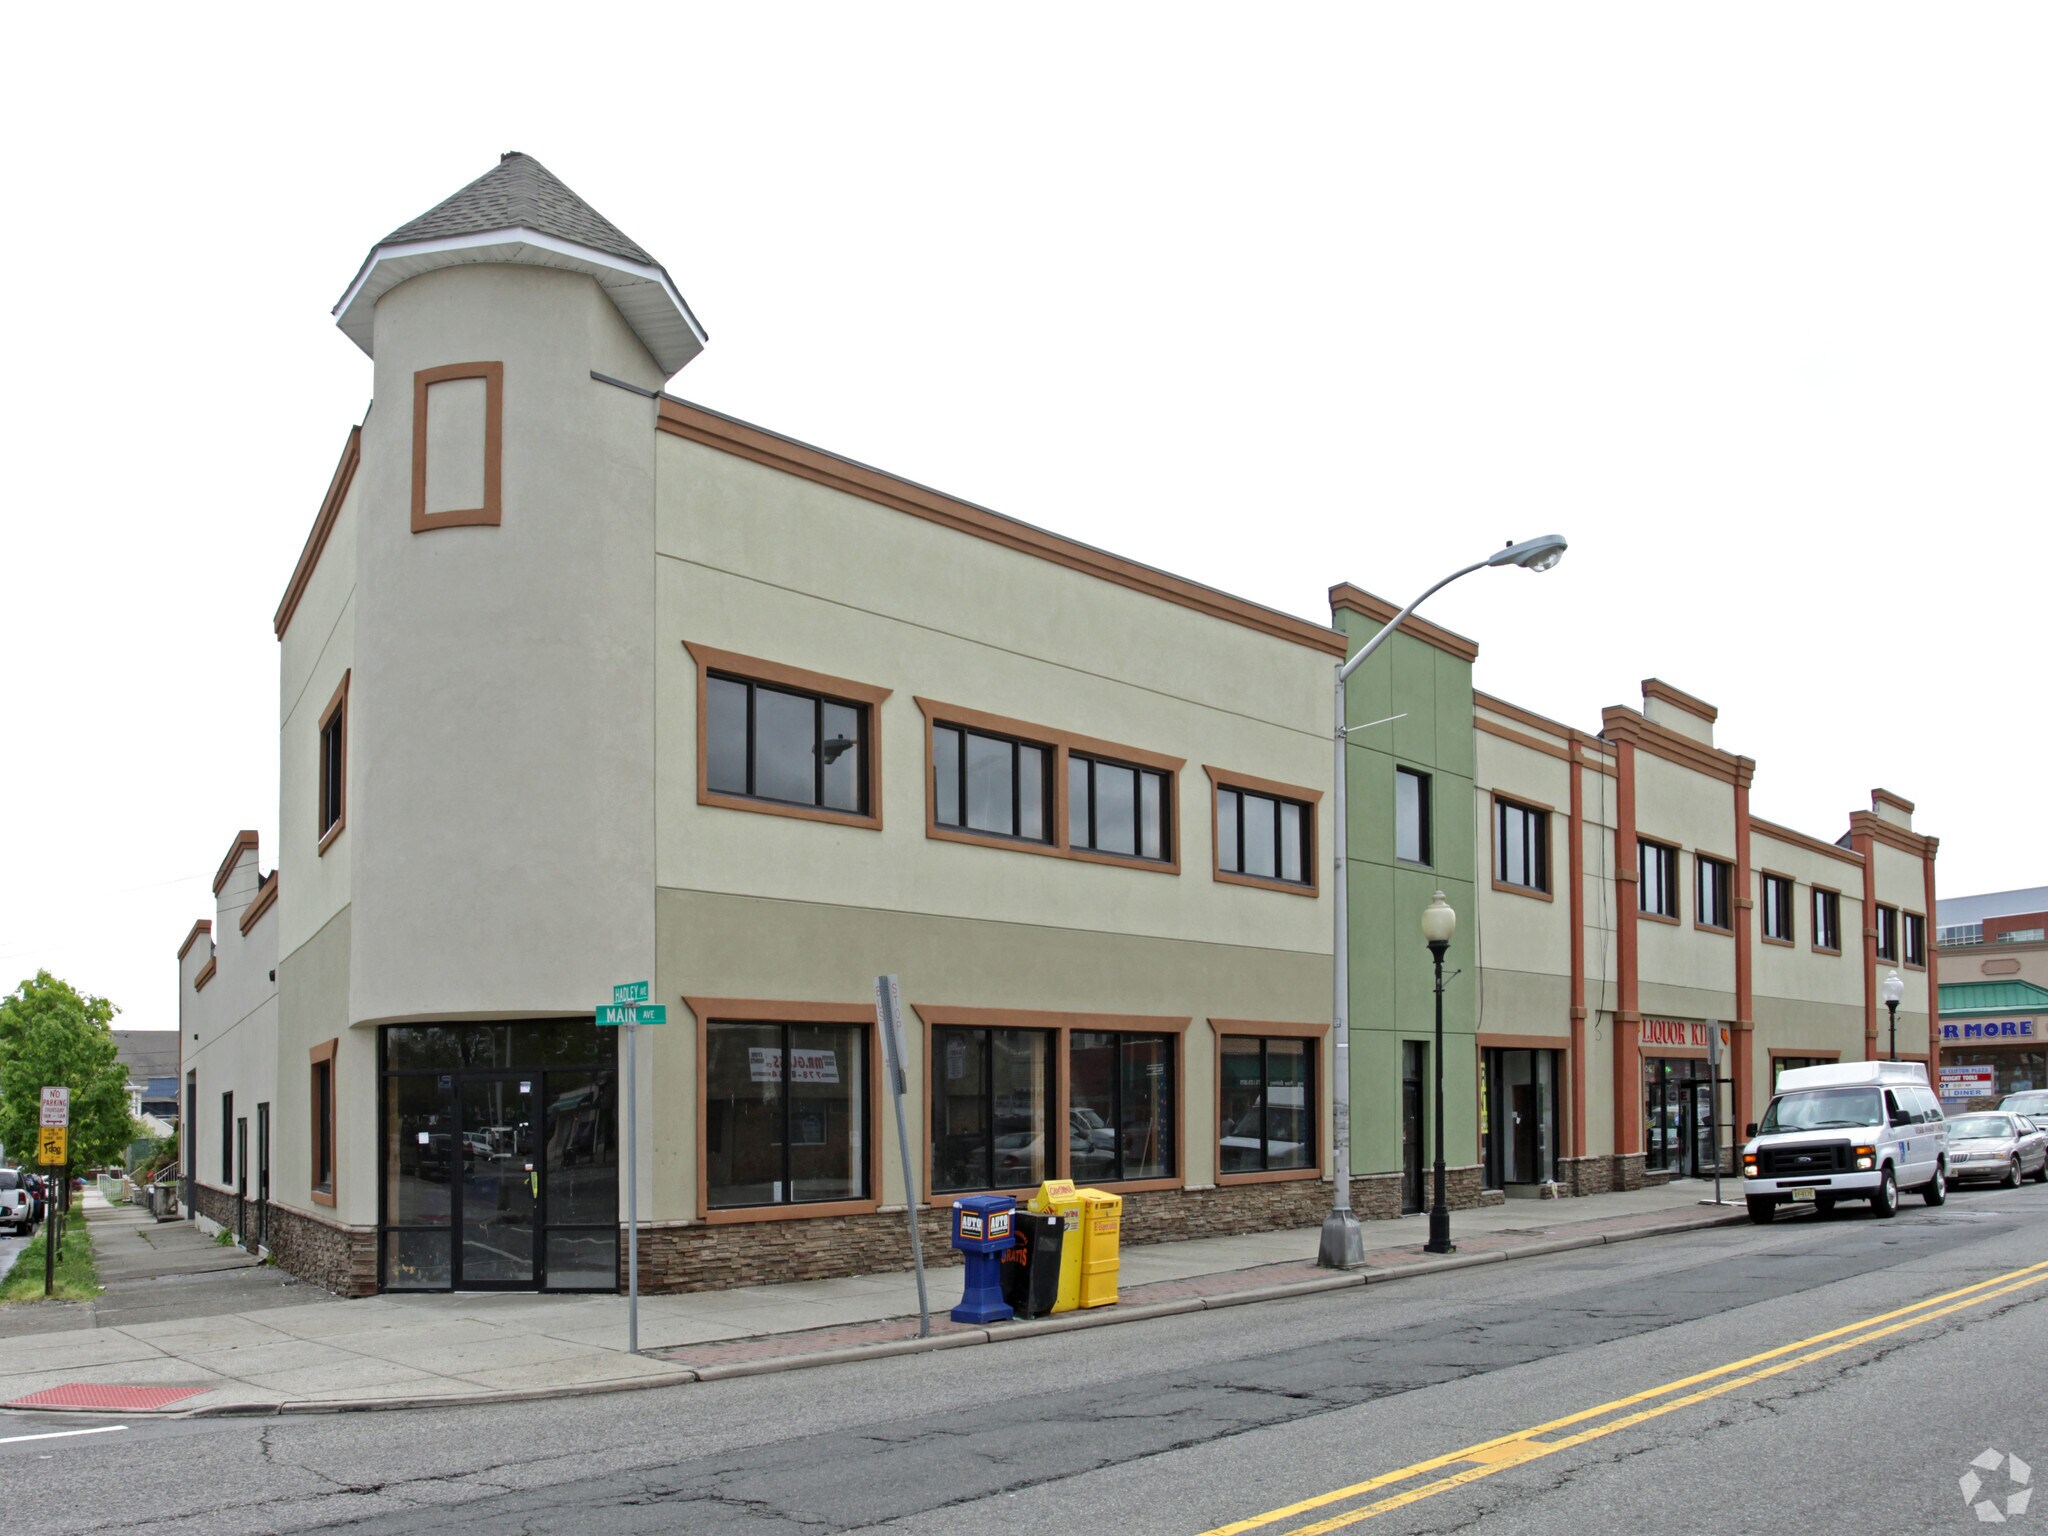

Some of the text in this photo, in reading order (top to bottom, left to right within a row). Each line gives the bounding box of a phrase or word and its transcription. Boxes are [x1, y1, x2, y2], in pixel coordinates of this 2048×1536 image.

[615, 985, 639, 1002] HADLEY
[891, 983, 902, 1030] STOP
[606, 1008, 655, 1023] MAIN AVE
[1641, 1019, 1685, 1044] LIQUOR
[1964, 1021, 2033, 1038] MORE
[50, 1090, 60, 1098] NO
[43, 1099, 67, 1107] PARKING
[962, 1215, 983, 1229] AUTO
[991, 1214, 1008, 1228] AUTO
